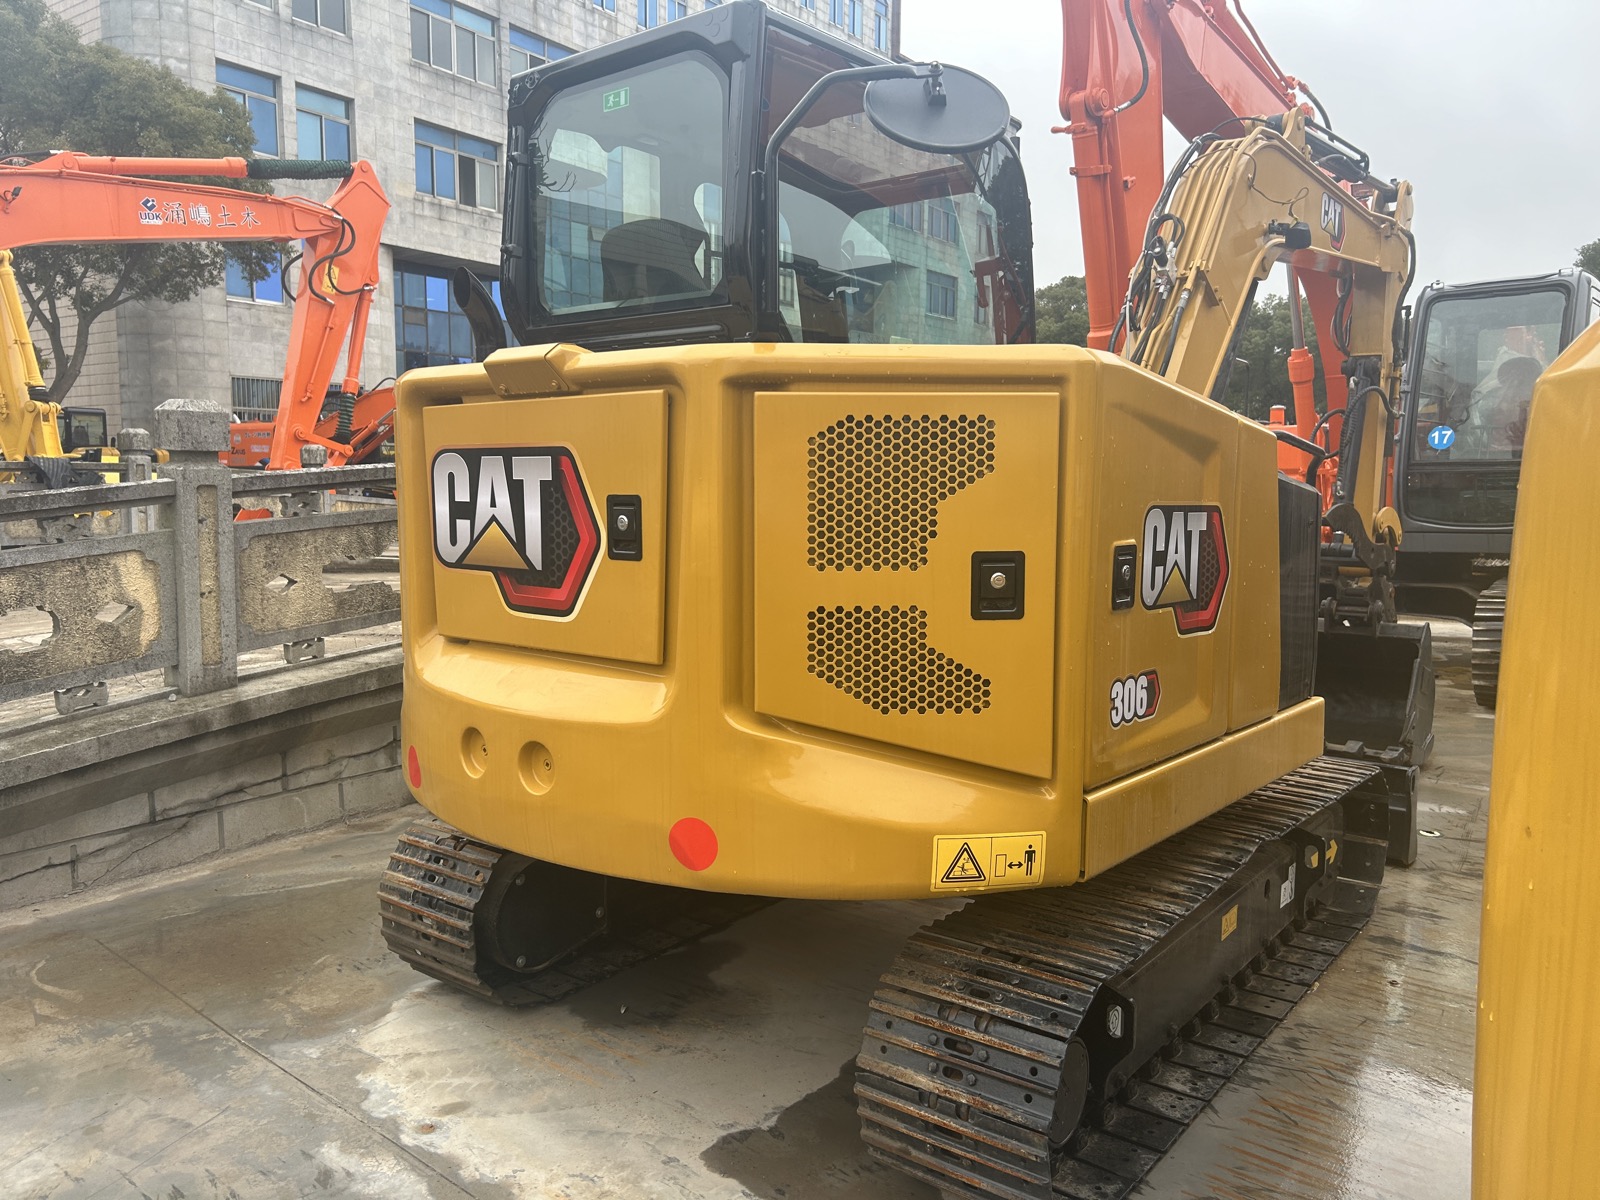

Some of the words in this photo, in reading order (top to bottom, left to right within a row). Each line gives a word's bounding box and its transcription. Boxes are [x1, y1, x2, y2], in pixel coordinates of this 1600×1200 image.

[139, 211, 163, 221] UDK
[1321, 192, 1342, 238] CAT
[1431, 430, 1453, 445] 17
[433, 452, 553, 571] CAT
[1142, 508, 1208, 606] CAT
[1111, 675, 1148, 724] 306
